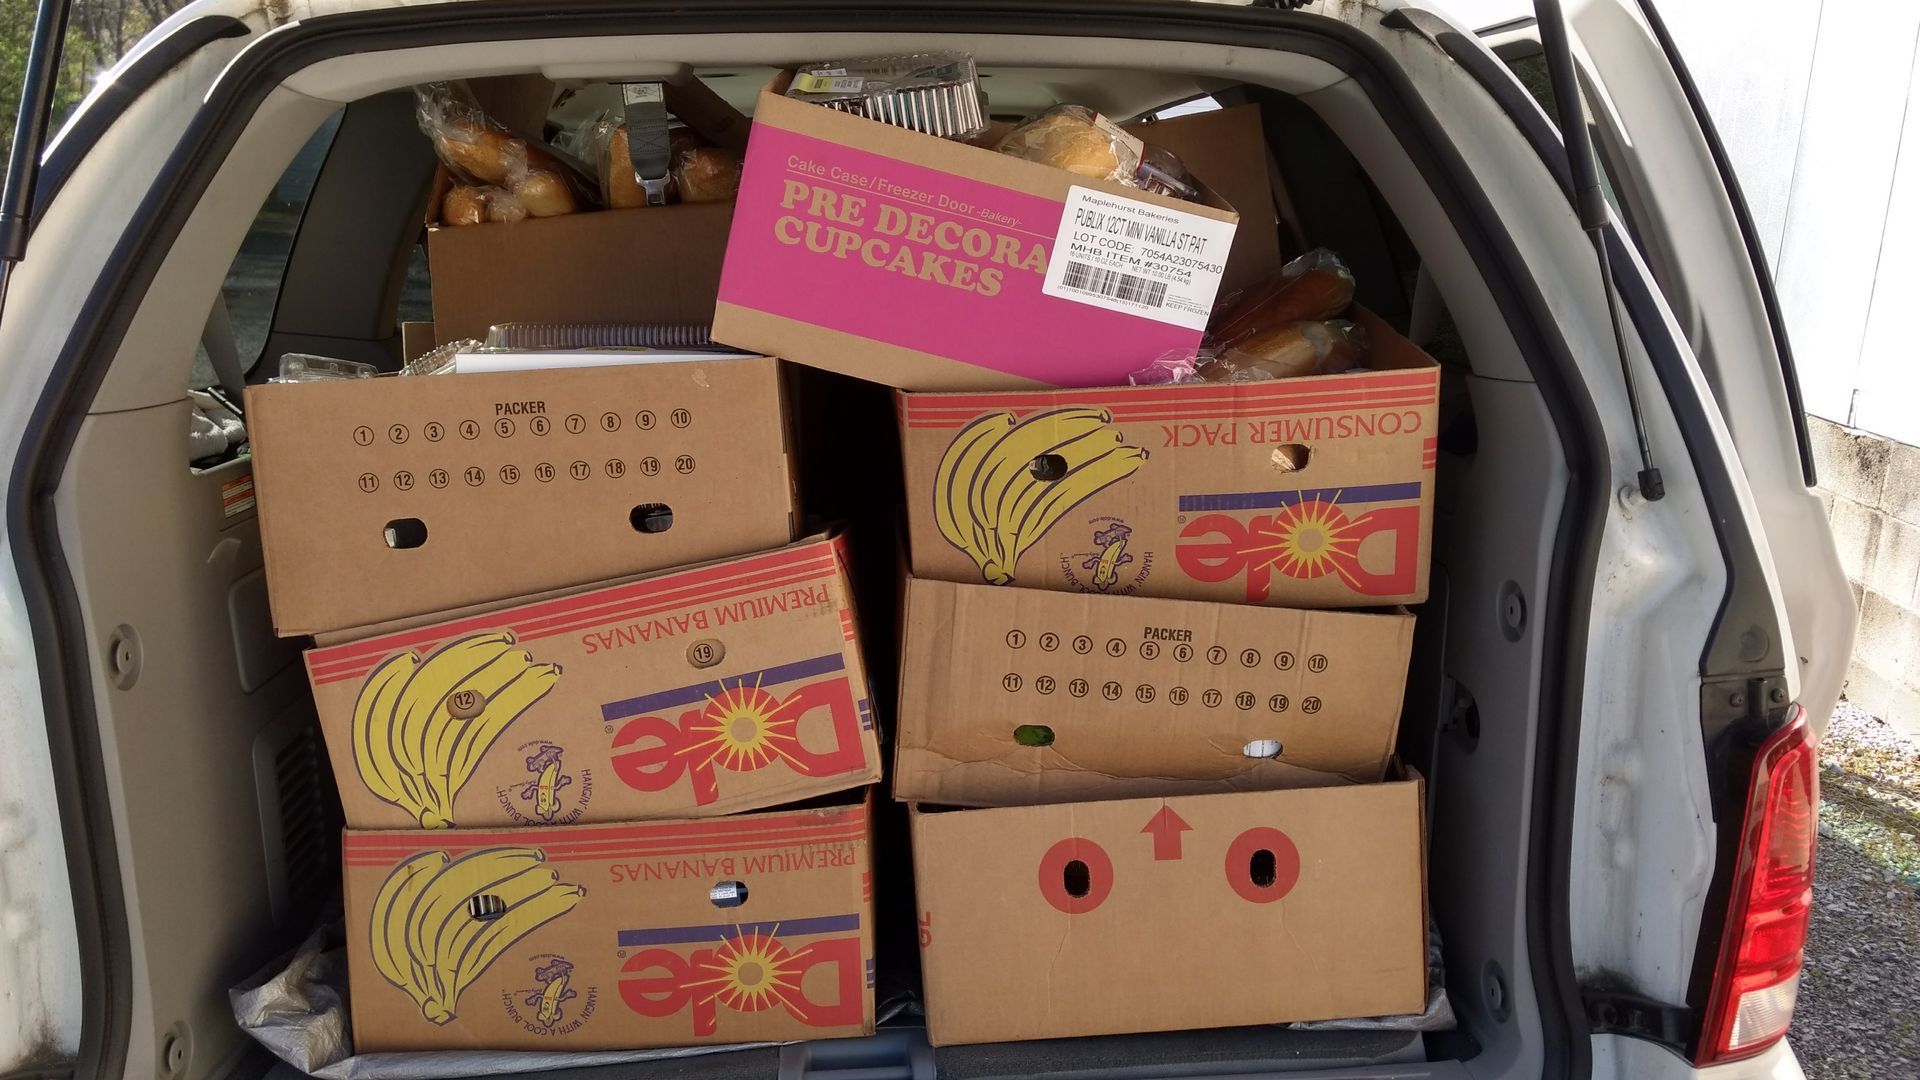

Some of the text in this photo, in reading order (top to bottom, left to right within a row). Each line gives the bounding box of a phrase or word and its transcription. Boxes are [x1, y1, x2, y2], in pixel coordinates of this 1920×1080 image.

[787, 155, 825, 175] Cake
[831, 167, 934, 204] Case/Freezer
[938, 194, 974, 215] Door
[780, 179, 1049, 275] PRE DECORA
[1082, 195, 1179, 224] Maplehurst Bakeries
[1075, 208, 1207, 255] PUBLIX 12CT MINI VANILLA ST PAT
[774, 216, 1003, 296] CUPCAKES
[1071, 243, 1192, 277] MHB ITEM #30754
[1074, 232, 1222, 274] LOT CODE: 7054A23075430
[1076, 252, 1091, 261] UNITS
[1108, 259, 1123, 269] EACH
[1132, 265, 1143, 273] NET
[1165, 302, 1209, 316] KEEP FROZEN
[495, 401, 545, 415] PACKER
[673, 411, 688, 425] 10
[1162, 410, 1422, 448] CONSUMER PACK
[361, 457, 693, 489] 11 12 13 14 15 16 17 18 19 20
[1061, 556, 1079, 586] BUNCH
[1175, 505, 1421, 603] Dole
[581, 584, 830, 654] PREMIUM BANANAS
[1144, 626, 1192, 642] PACKER
[696, 646, 712, 660] 19
[1311, 657, 1325, 670] 10
[456, 693, 471, 706] 12
[1005, 675, 1320, 711] 11 12 13 14 15 16 17 18 19 20
[611, 676, 867, 807] Dole
[496, 790, 522, 821] BUNCH
[609, 847, 856, 883] PREMIUM BANANAS
[618, 934, 863, 1037] Dole
[502, 987, 597, 1036] HANGIN' WITH A COOL BUNCH
